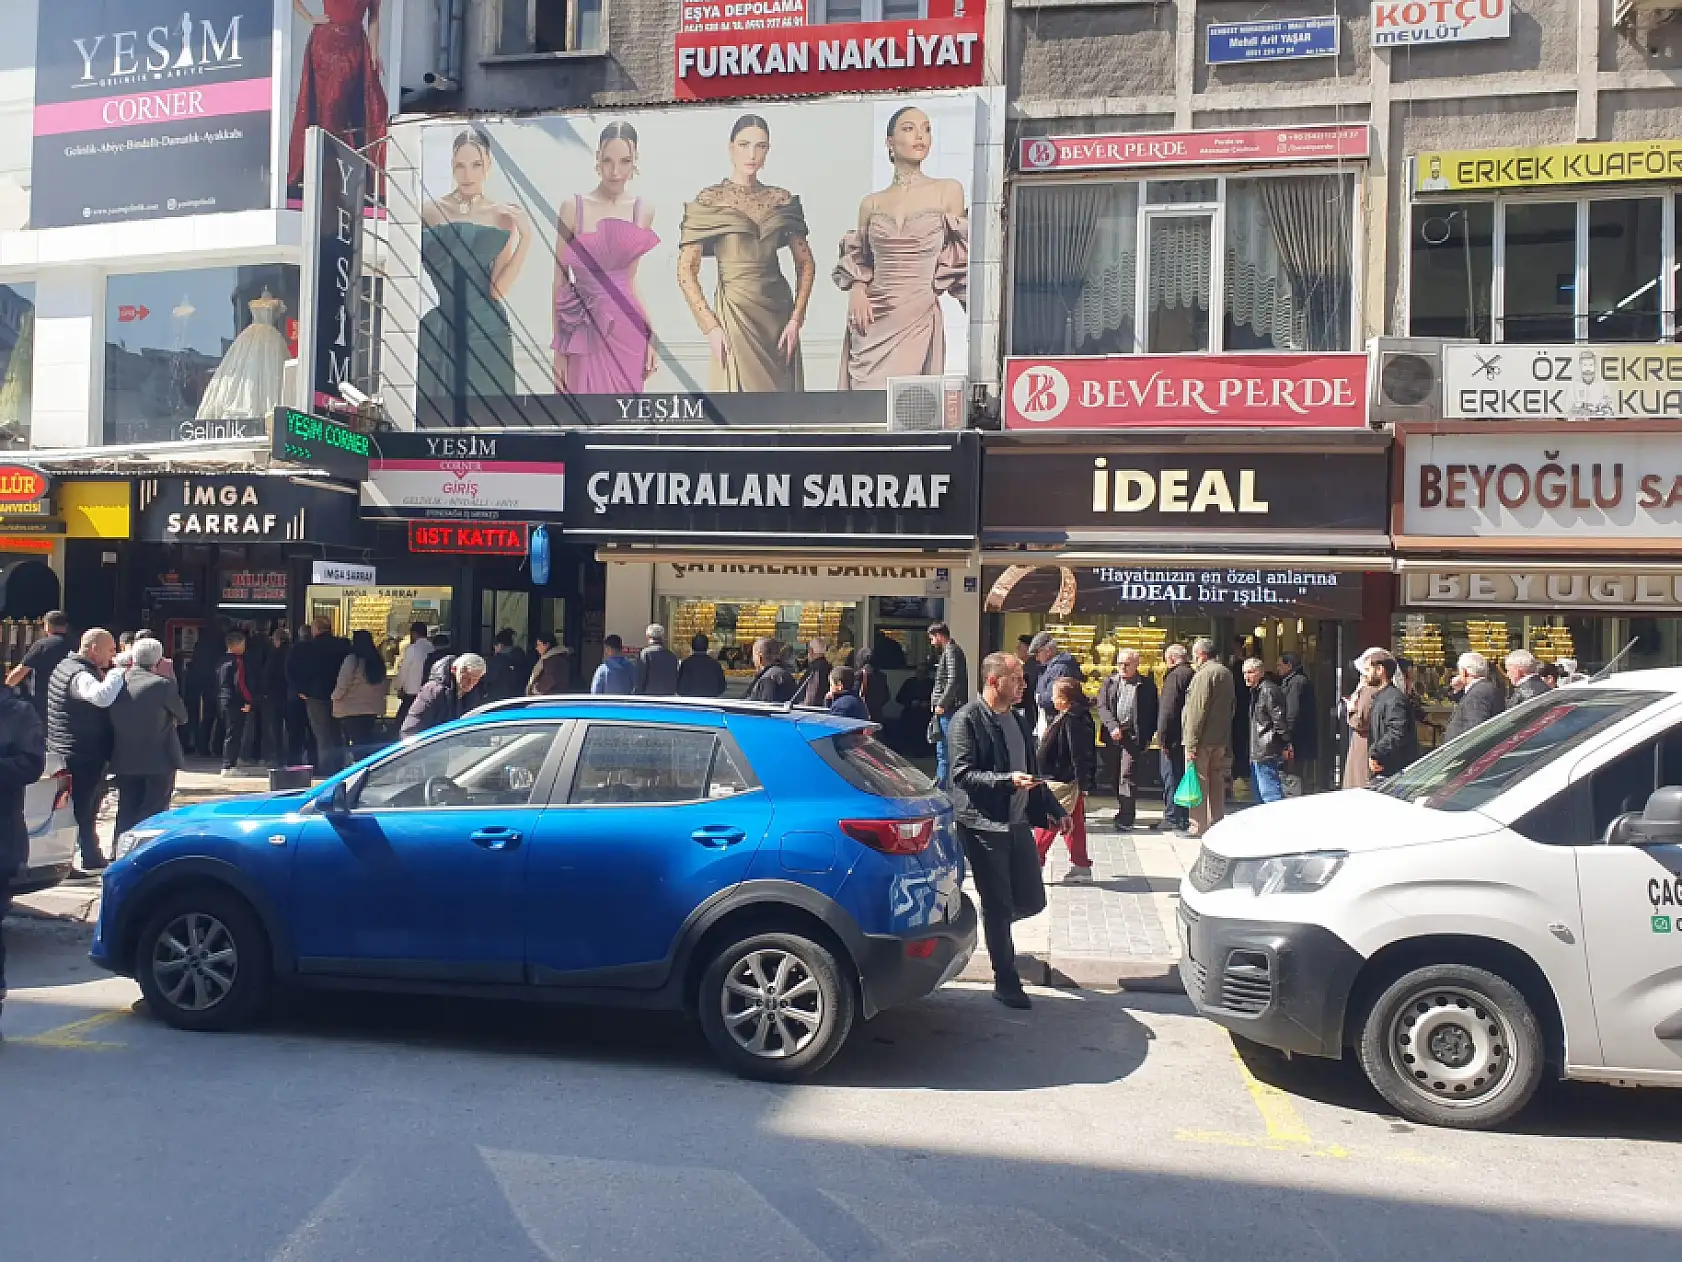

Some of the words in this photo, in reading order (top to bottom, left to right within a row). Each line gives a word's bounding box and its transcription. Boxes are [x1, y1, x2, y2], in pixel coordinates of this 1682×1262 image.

[684, 4, 720, 22] EŞYA
[725, 0, 803, 18] DEPOLAMA
[679, 41, 808, 78] FURKAN
[818, 29, 978, 70] NAKLİYAT
[102, 90, 204, 124] CORNER
[1061, 141, 1124, 160] BEVER
[1124, 140, 1187, 158] PERDE
[1457, 156, 1554, 183] ERKEK
[1563, 145, 1682, 177] KUAFÖR
[1532, 350, 1573, 381] ÖZ
[1600, 357, 1682, 381] EKRE
[1078, 370, 1220, 414] BEVER
[1219, 377, 1356, 414] PERDE
[1459, 389, 1564, 413] ERKEK
[1619, 389, 1682, 413] KUA
[179, 420, 247, 440] Gelinlik
[443, 480, 479, 498] GİRİŞ
[586, 470, 790, 514] ÇAYIRALAN
[802, 473, 950, 509] SARRAF
[1092, 457, 1269, 514] İDEAL
[1419, 450, 1624, 509] BEYOĞLU
[183, 480, 259, 507] İMGA
[167, 513, 277, 534] SARRAF
[457, 528, 520, 547] KATTA
[1201, 571, 1221, 583] en
[1227, 569, 1261, 584] özel
[1266, 569, 1337, 585] anlarına
[1198, 584, 1227, 602] bir
